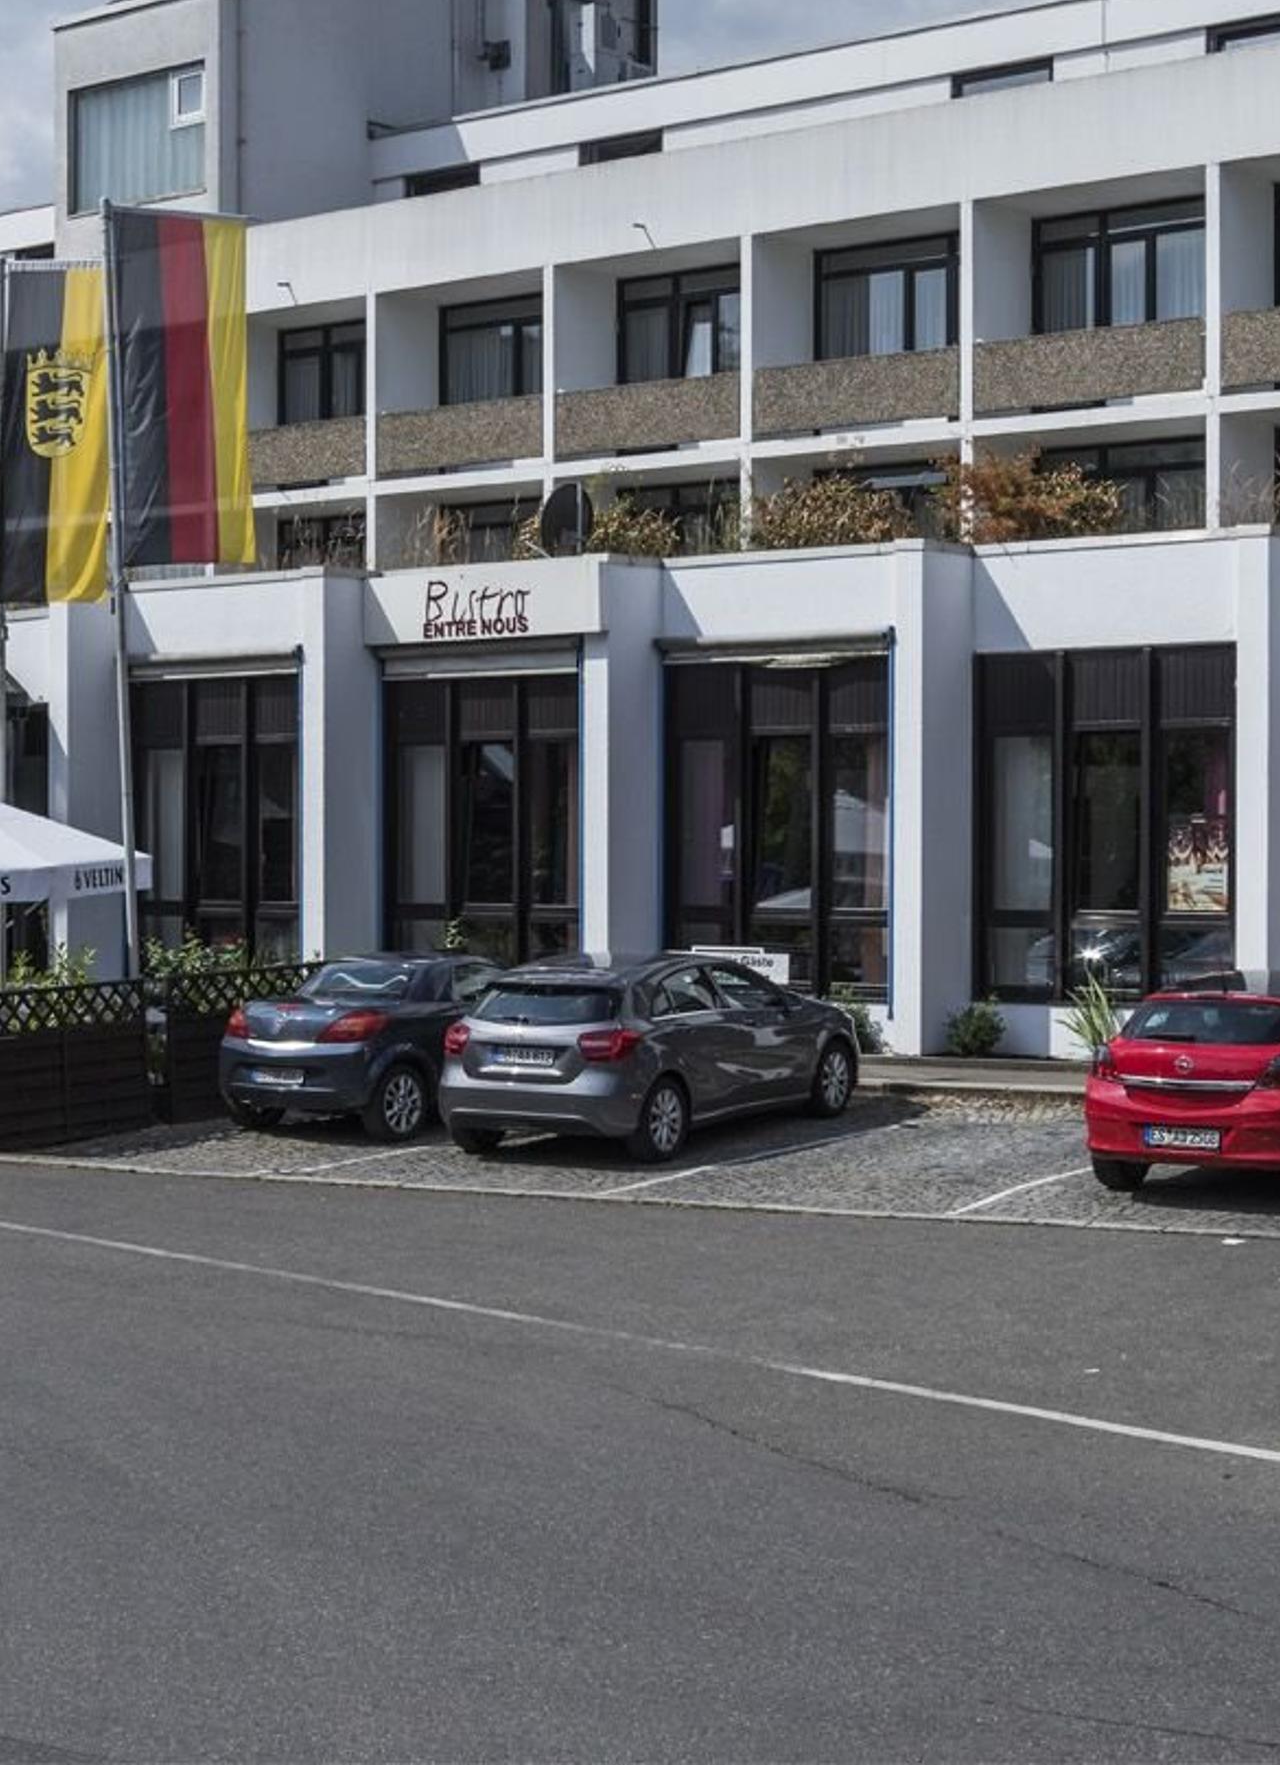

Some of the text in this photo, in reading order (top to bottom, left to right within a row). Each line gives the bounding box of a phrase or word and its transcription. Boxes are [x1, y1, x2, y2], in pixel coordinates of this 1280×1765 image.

[425, 574, 531, 623] Bistro
[423, 616, 529, 639] ENTRE NOUS
[83, 866, 124, 889] VELTIN
